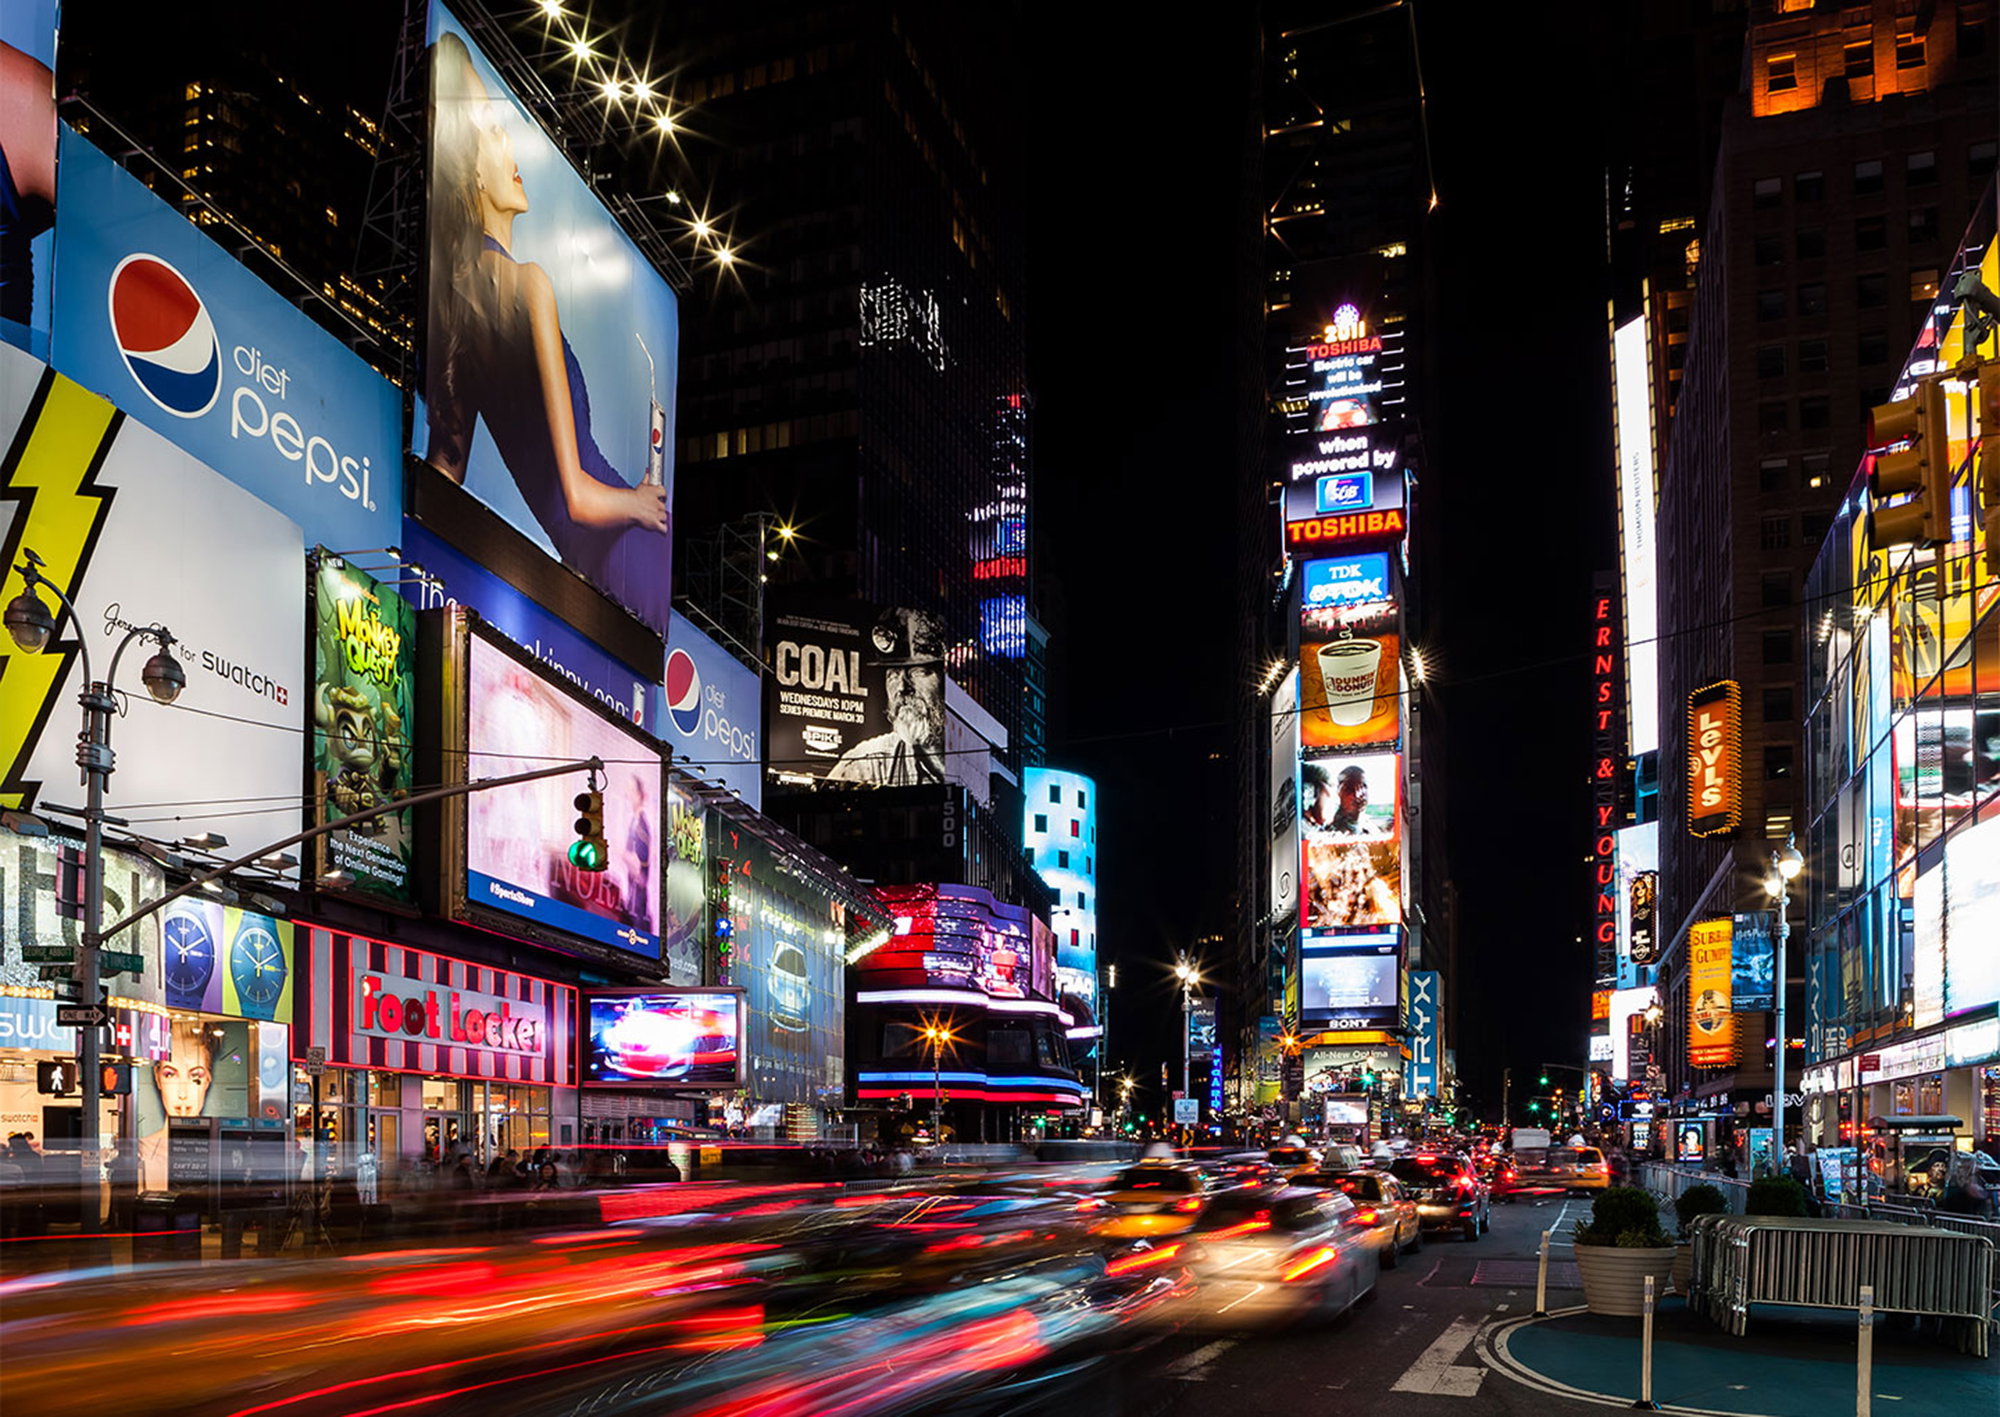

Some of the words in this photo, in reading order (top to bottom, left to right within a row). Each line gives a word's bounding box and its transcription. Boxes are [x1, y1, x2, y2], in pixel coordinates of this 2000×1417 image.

[1324, 320, 1366, 343] 2011
[1307, 337, 1382, 360] TOSHIBA
[1356, 355, 1375, 366] car
[233, 346, 291, 400] diet
[230, 386, 371, 509] pepsi
[1318, 436, 1368, 455] when
[1292, 451, 1369, 480] powered
[1373, 449, 1396, 469] by
[1287, 511, 1403, 542] TOSHIBA
[1328, 564, 1363, 580] TDK
[179, 645, 196, 662] for
[202, 651, 275, 700] swatch
[776, 640, 868, 697] COAL
[1595, 600, 1613, 731] ERNST
[704, 683, 726, 710] diet
[780, 691, 840, 710] WEDNESDAYS
[841, 700, 864, 713] 10PM
[780, 704, 802, 716] SERIES
[802, 707, 832, 720] PREMIERE
[833, 711, 855, 723] MARCH
[855, 714, 864, 724] 30
[704, 708, 756, 762] pepsi
[1596, 757, 1614, 778] &
[943, 786, 955, 847] 1500
[349, 830, 392, 854] Experience
[334, 854, 344, 864] of
[344, 857, 370, 874] Online
[345, 843, 365, 858] Next
[365, 850, 407, 873] Generation
[1597, 806, 1615, 943] YOUNG
[64, 1011, 76, 1019] ONE
[85, 1011, 100, 1019] WAY
[361, 975, 441, 1039] Foot
[450, 991, 544, 1053] Locker
[1329, 1018, 1371, 1029] SONY
[1413, 975, 1431, 1096] TRYX
[1312, 1050, 1350, 1060] All-New
[1, 1114, 33, 1123] swatch
